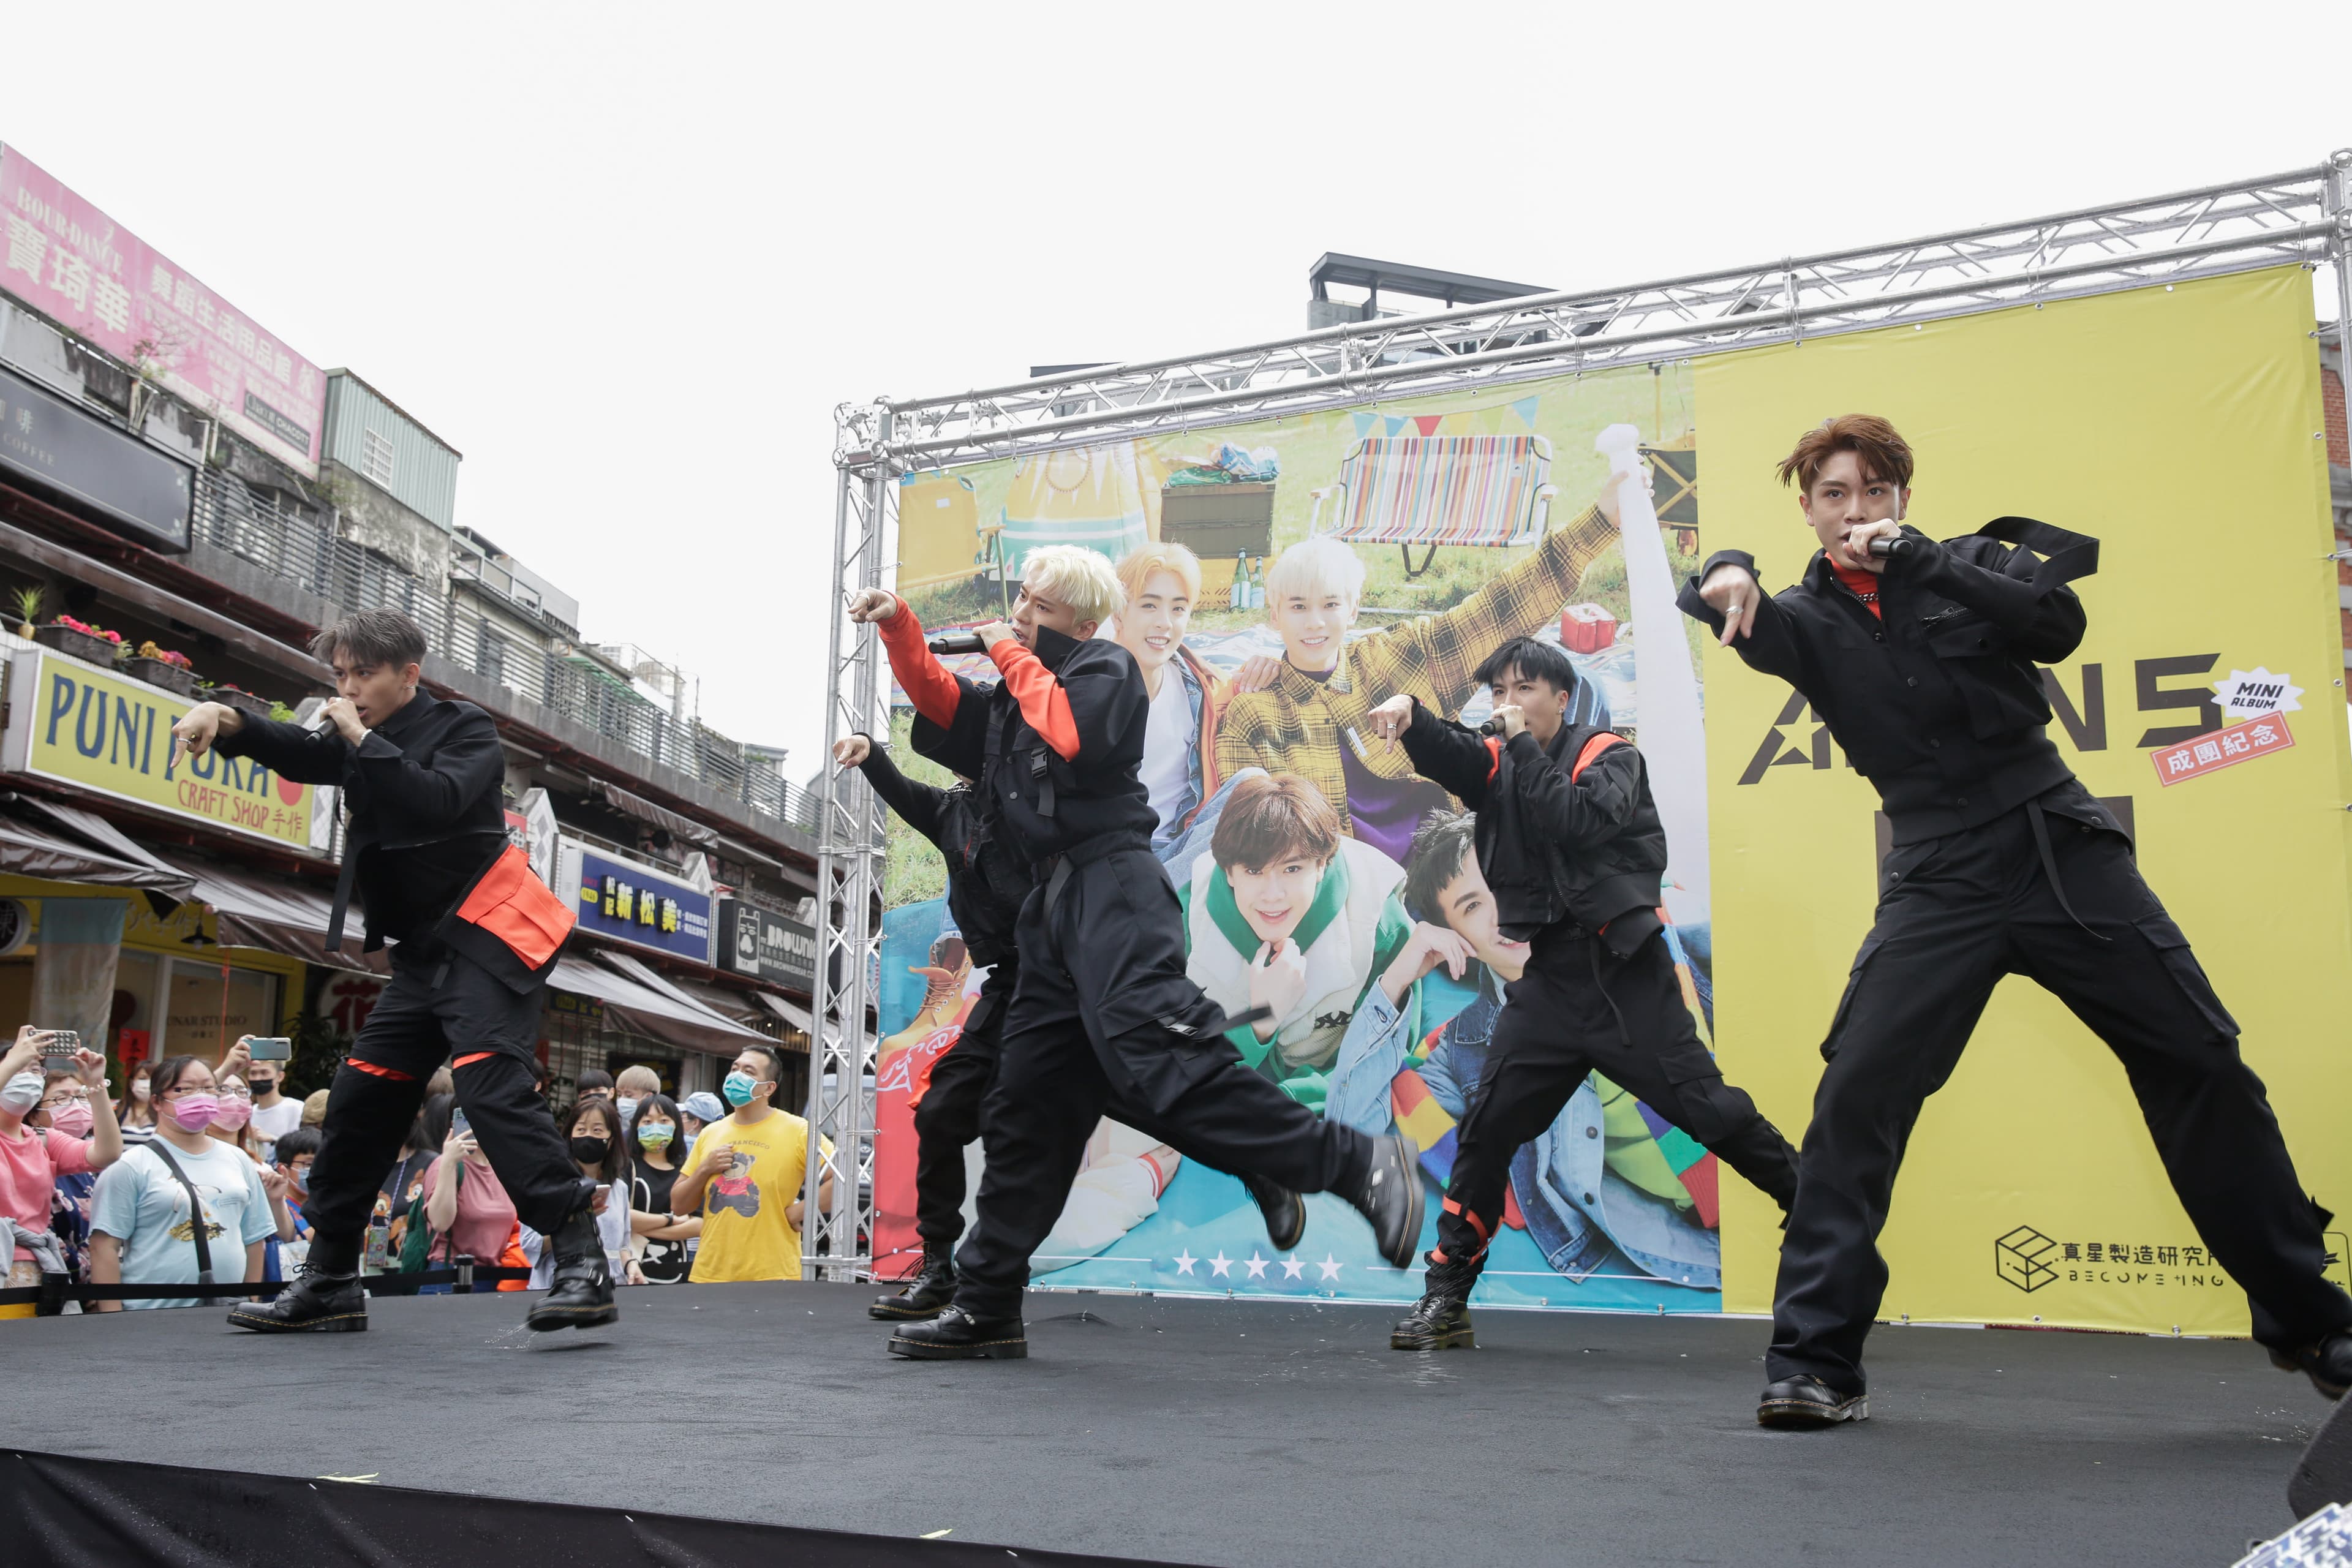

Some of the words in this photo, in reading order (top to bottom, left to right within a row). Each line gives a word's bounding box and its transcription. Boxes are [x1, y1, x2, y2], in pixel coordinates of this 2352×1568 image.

[6, 212, 131, 334] 寶琦華
[3, 432, 55, 467] COFFEE
[2231, 697, 2277, 709] ALBUM
[2236, 682, 2284, 698] MINI
[47, 673, 156, 775] PUNI
[2167, 724, 2279, 775] 成團紀念
[178, 779, 228, 818] CRAFT
[232, 796, 270, 830] SHOP
[272, 808, 303, 839] 手作
[729, 1139, 770, 1150] RANCISCO
